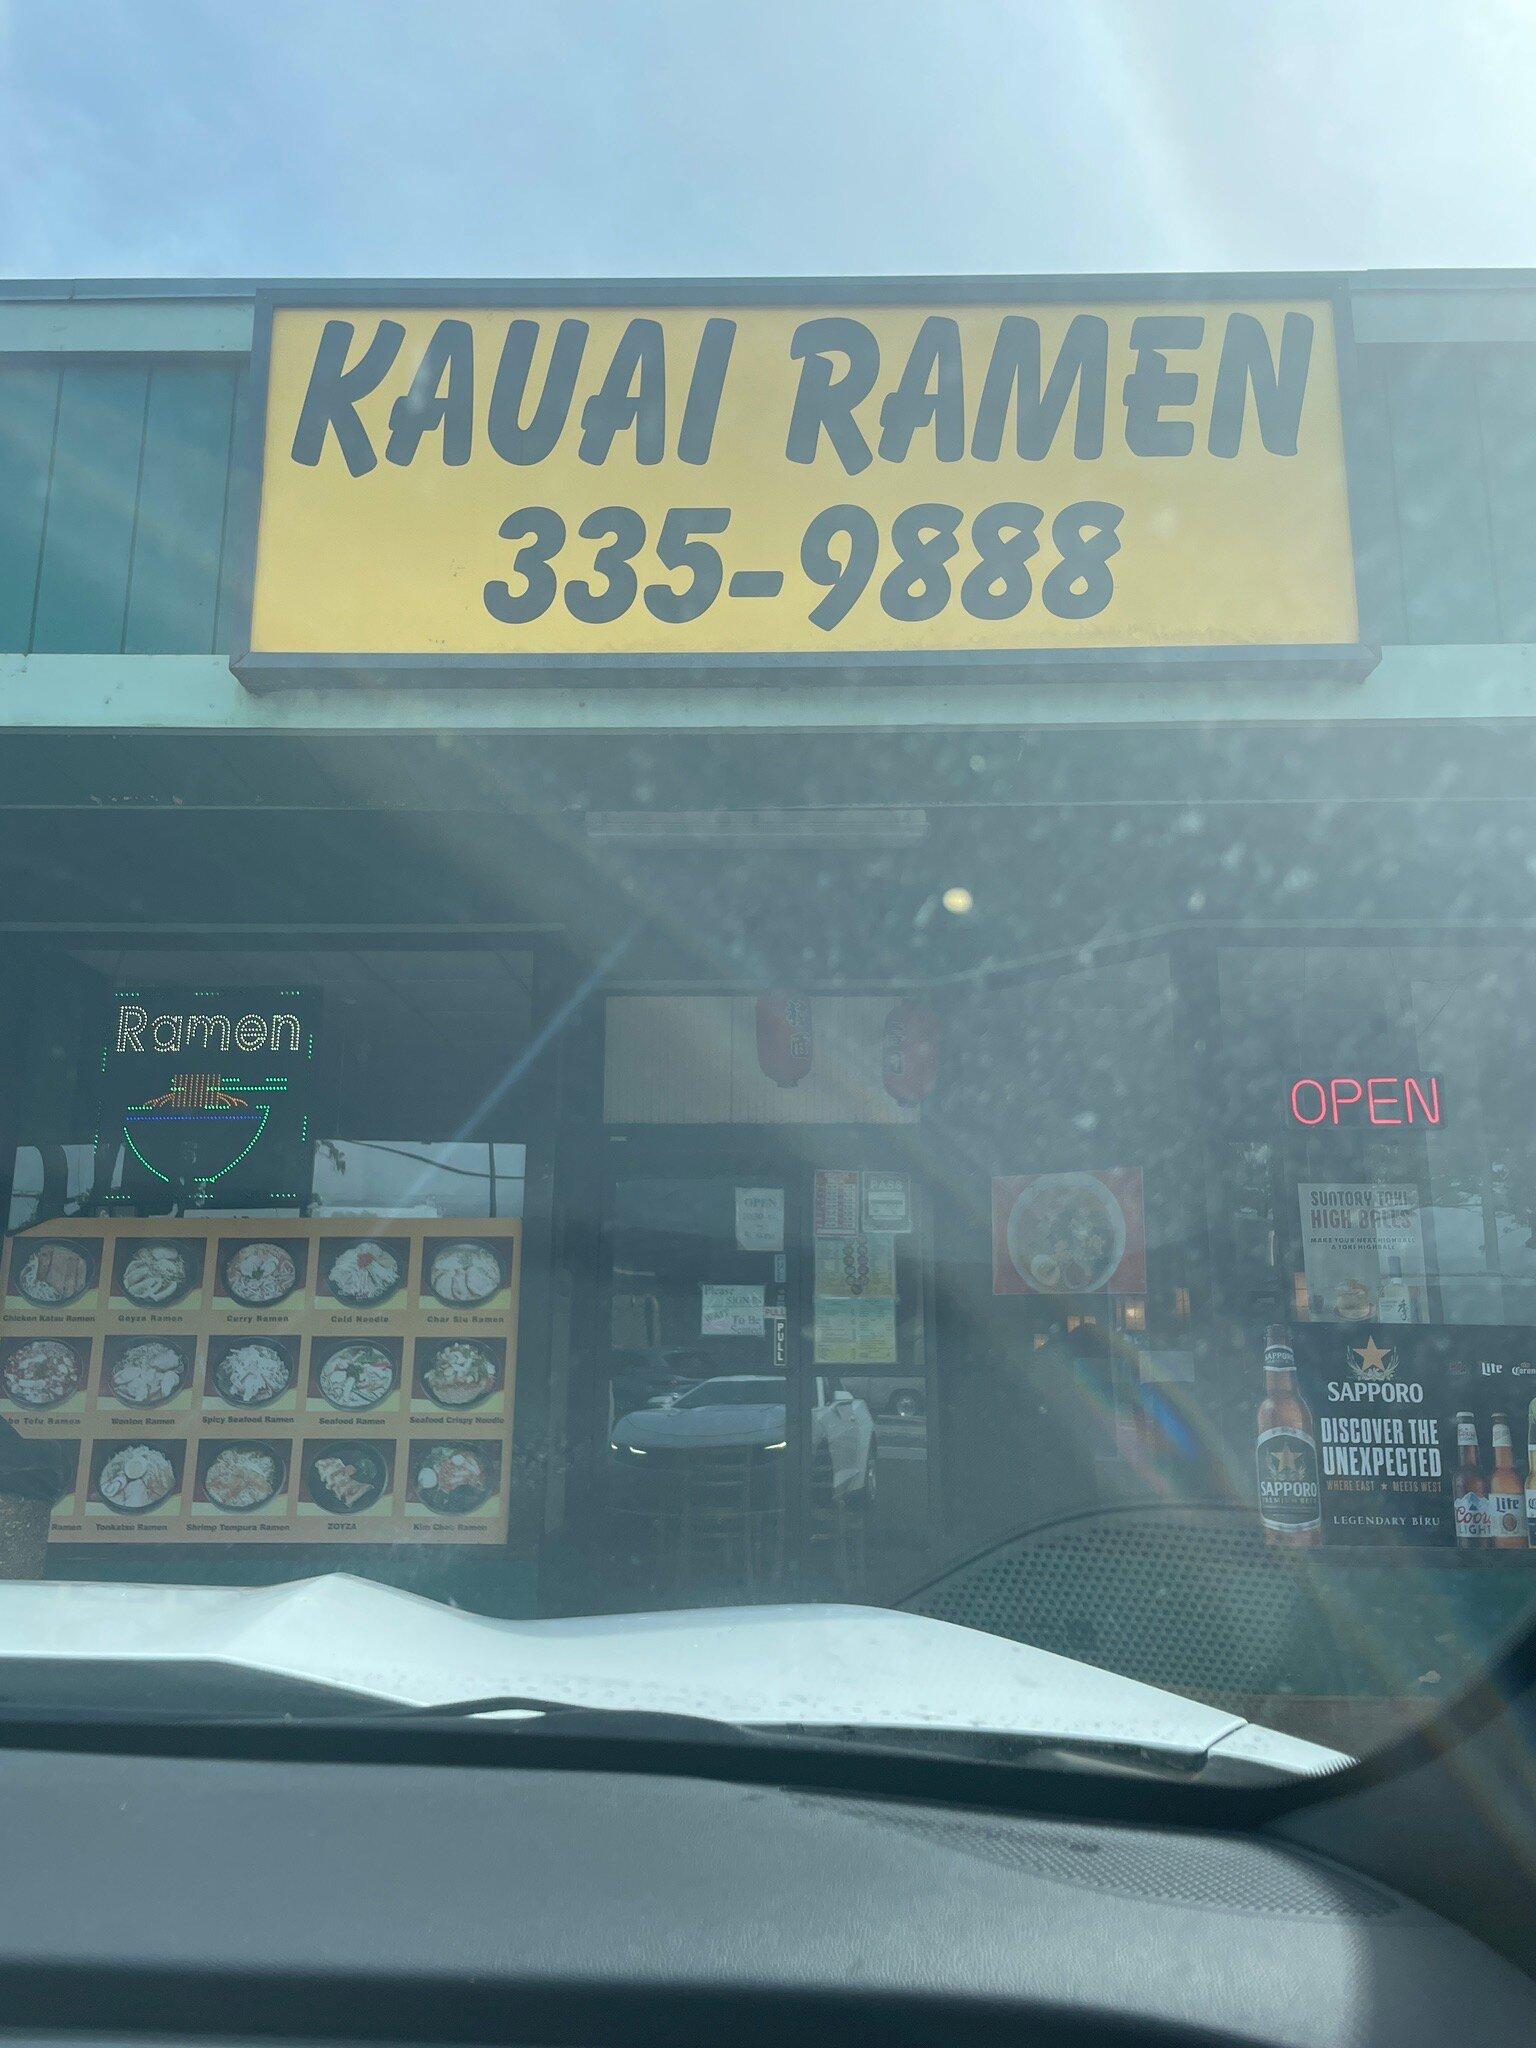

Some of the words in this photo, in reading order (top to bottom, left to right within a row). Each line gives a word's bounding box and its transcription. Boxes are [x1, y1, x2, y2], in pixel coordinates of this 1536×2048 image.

[292, 318, 736, 478] KAUAI
[787, 312, 1314, 476] RAMEN
[484, 501, 1125, 630] 335-9888
[116, 1005, 300, 1052] Ramen
[1290, 1077, 1441, 1126] OPEN
[1310, 1191, 1372, 1206] SUNTORY
[1311, 1209, 1352, 1229] HIGH
[66, 1315, 96, 1323] Ramen
[151, 1315, 183, 1323] Ramen
[227, 1315, 253, 1324] Curry
[257, 1315, 289, 1323] Ramen
[472, 1315, 504, 1323] Ramen
[1327, 1381, 1424, 1403] SAPPORO
[48, 1417, 81, 1425] Ramen
[146, 1417, 175, 1425] Ramen
[228, 1415, 262, 1423] Seafood
[264, 1415, 294, 1423] Ramen
[319, 1417, 354, 1425] Seafood
[356, 1417, 386, 1425] Ramen
[409, 1416, 444, 1424] Seafood
[1320, 1417, 1404, 1444] DISCOVER
[1408, 1419, 1439, 1445] THE
[1322, 1446, 1442, 1477] UNEXPECTED
[1260, 1481, 1317, 1497] SAPPORO
[1333, 1515, 1406, 1526] LEGENDARY
[137, 1523, 168, 1531] Ramen
[260, 1523, 290, 1531] Ramen
[457, 1523, 487, 1531] Ramen
